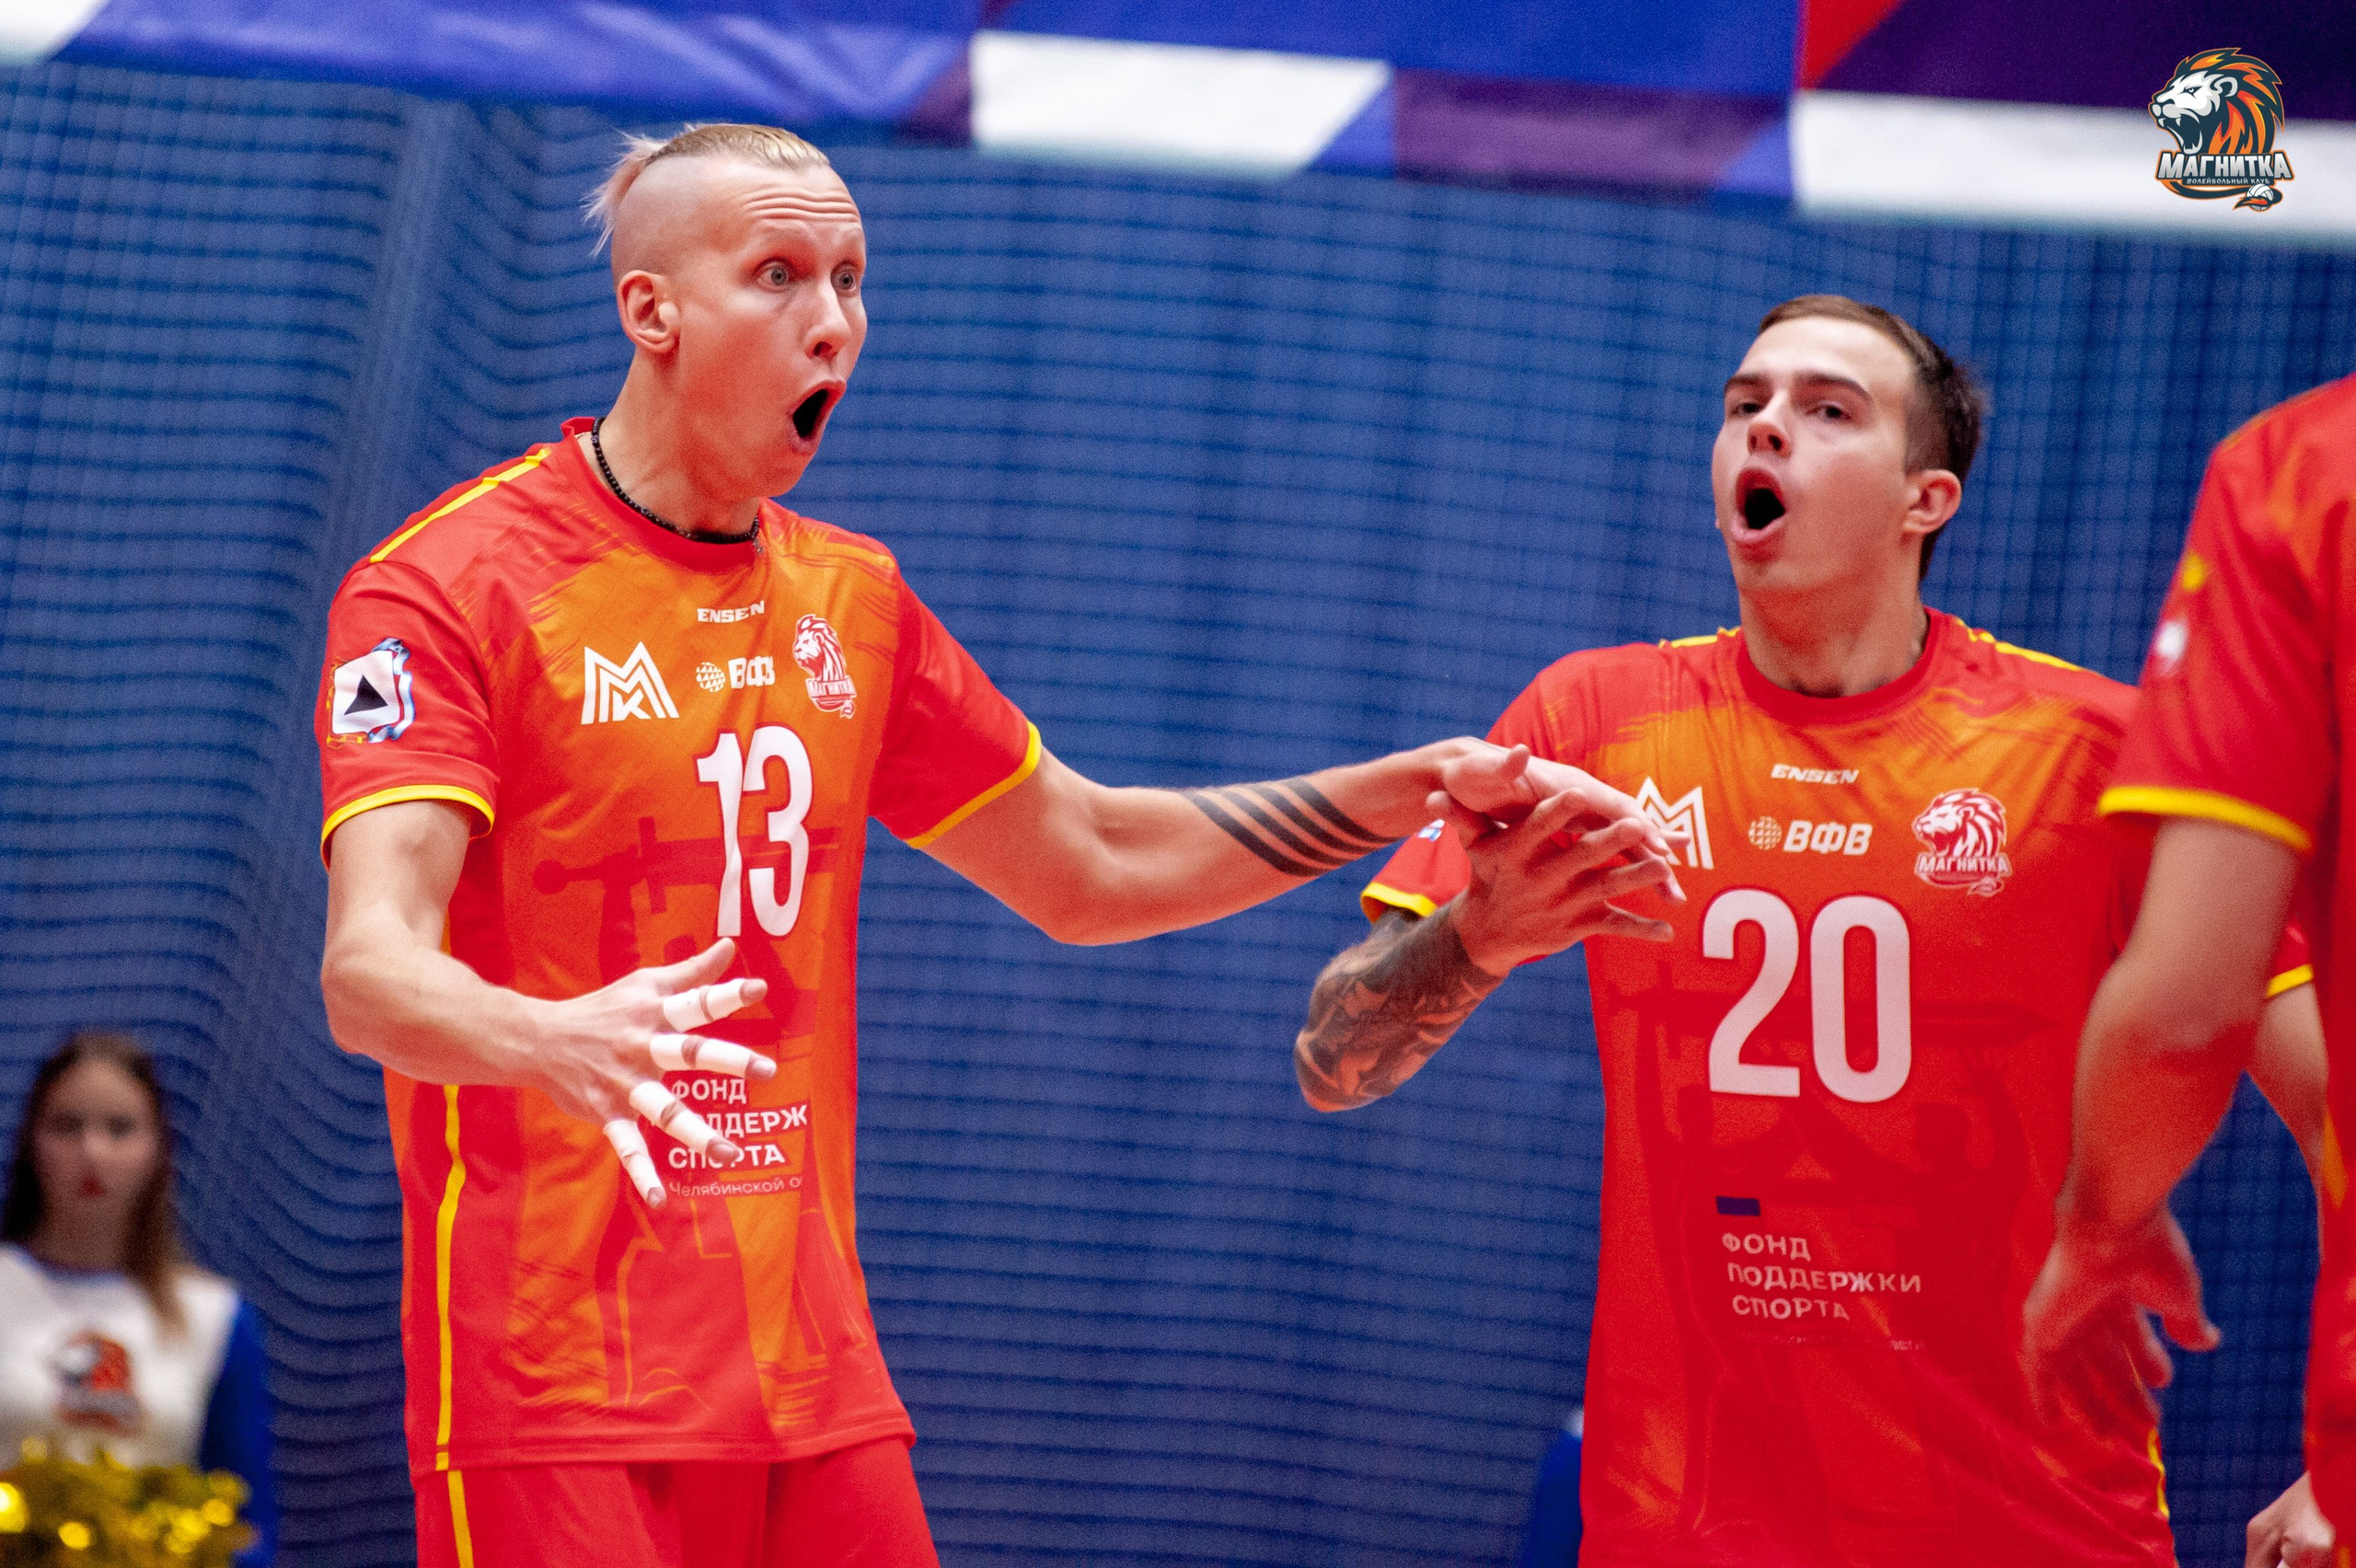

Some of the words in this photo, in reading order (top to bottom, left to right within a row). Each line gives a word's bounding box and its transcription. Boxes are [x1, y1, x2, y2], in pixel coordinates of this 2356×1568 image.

[696, 600, 766, 623] ENSEN
[728, 655, 776, 689] ВФВ
[1770, 763, 1859, 785] ENSEN
[696, 724, 814, 938] 13
[1783, 819, 1873, 856] ВФВ
[1917, 853, 2010, 873] МАГНИТКА
[1703, 888, 1912, 1104] 20
[671, 1078, 747, 1104] ФОНД
[669, 1176, 785, 1196] Челябинской
[1722, 1232, 1811, 1262] ФОНД
[1727, 1262, 1922, 1293] ПОДДЕРЖКИ
[1732, 1294, 1851, 1321] СПОРТА
